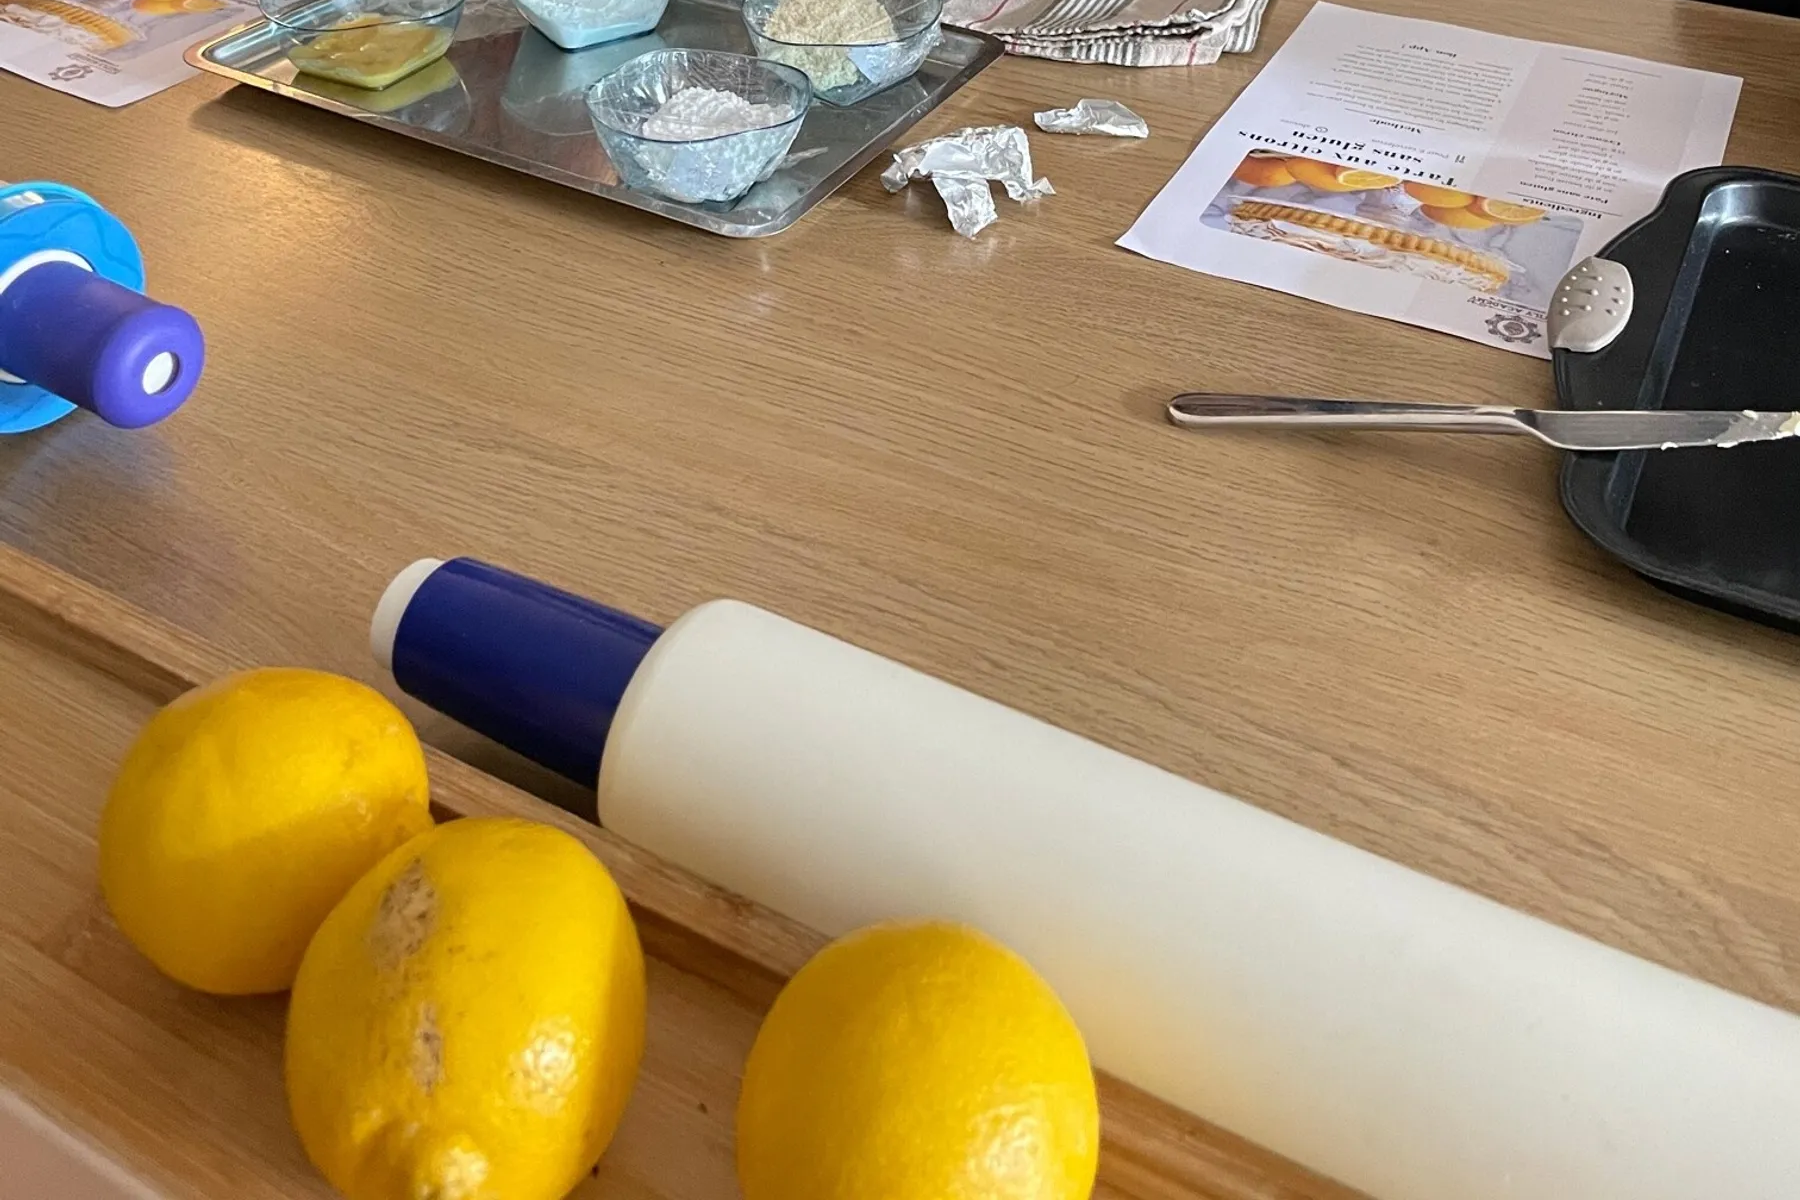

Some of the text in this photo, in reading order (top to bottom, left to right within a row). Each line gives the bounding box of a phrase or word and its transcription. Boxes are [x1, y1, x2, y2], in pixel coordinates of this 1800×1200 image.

[1291, 130, 1366, 152] gluten
[1237, 130, 1457, 189] Tarte aux citrons
[1372, 148, 1423, 164] sans
